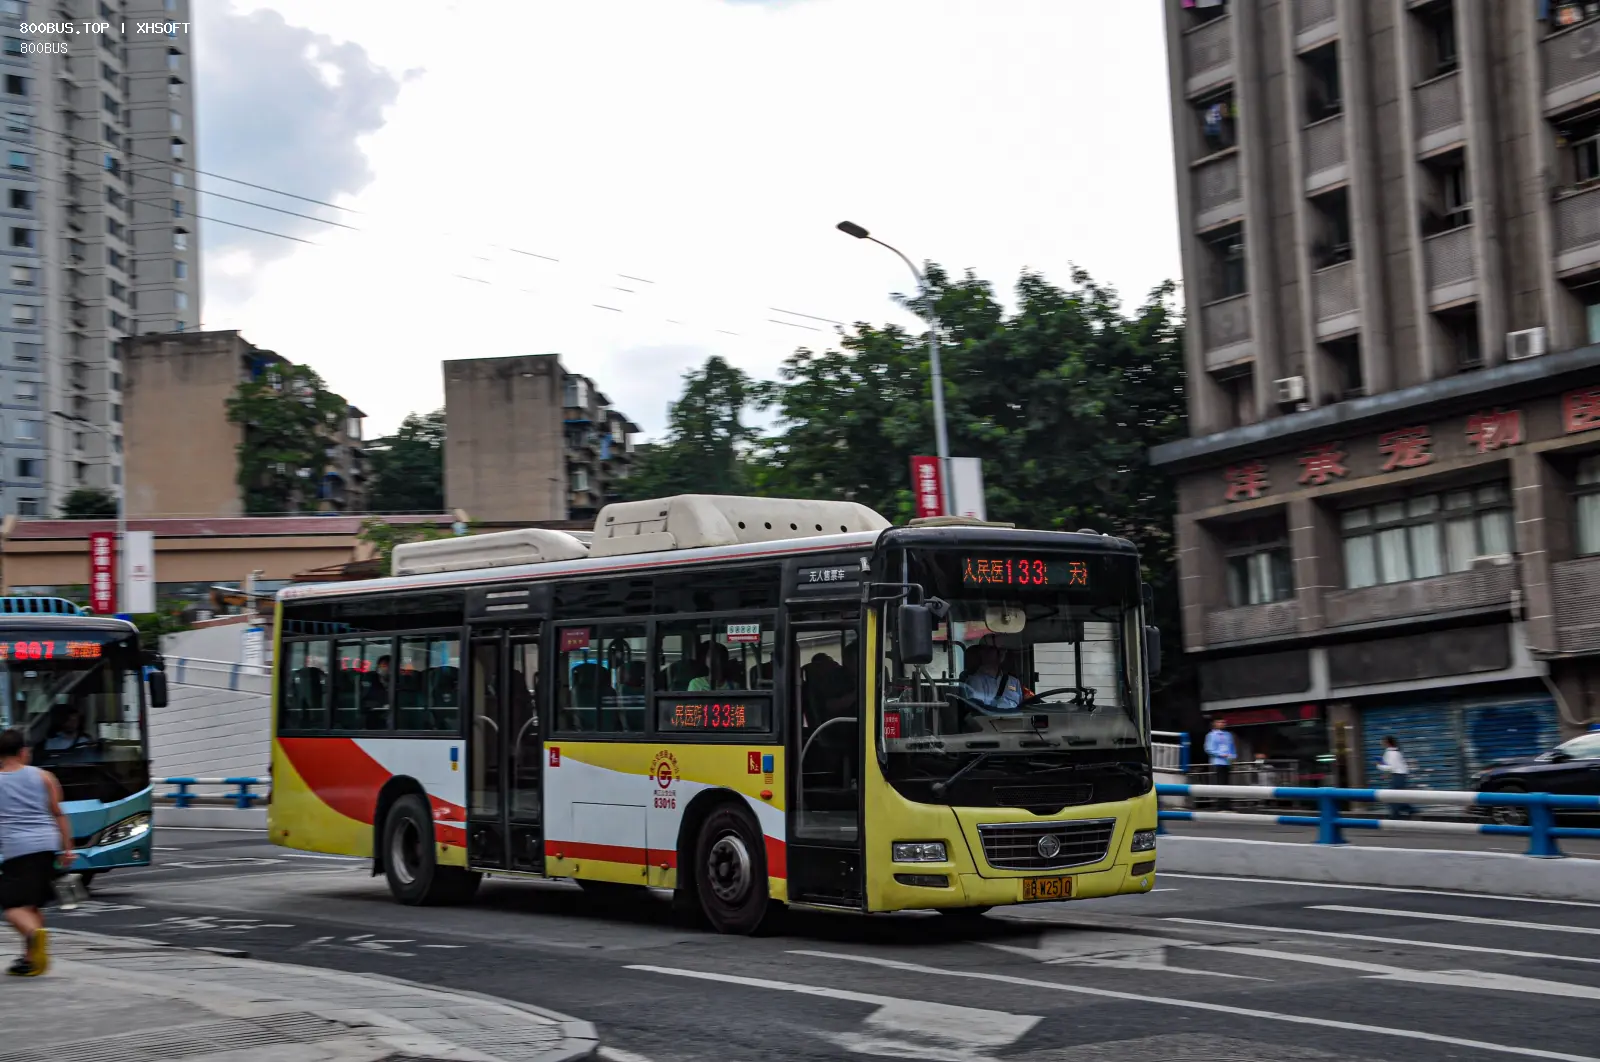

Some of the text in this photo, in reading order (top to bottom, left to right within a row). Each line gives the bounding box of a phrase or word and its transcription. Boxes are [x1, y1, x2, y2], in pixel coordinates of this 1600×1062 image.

[809, 569, 845, 583] 无人售票车
[1006, 559, 1044, 585] 133
[703, 703, 731, 728] 133
